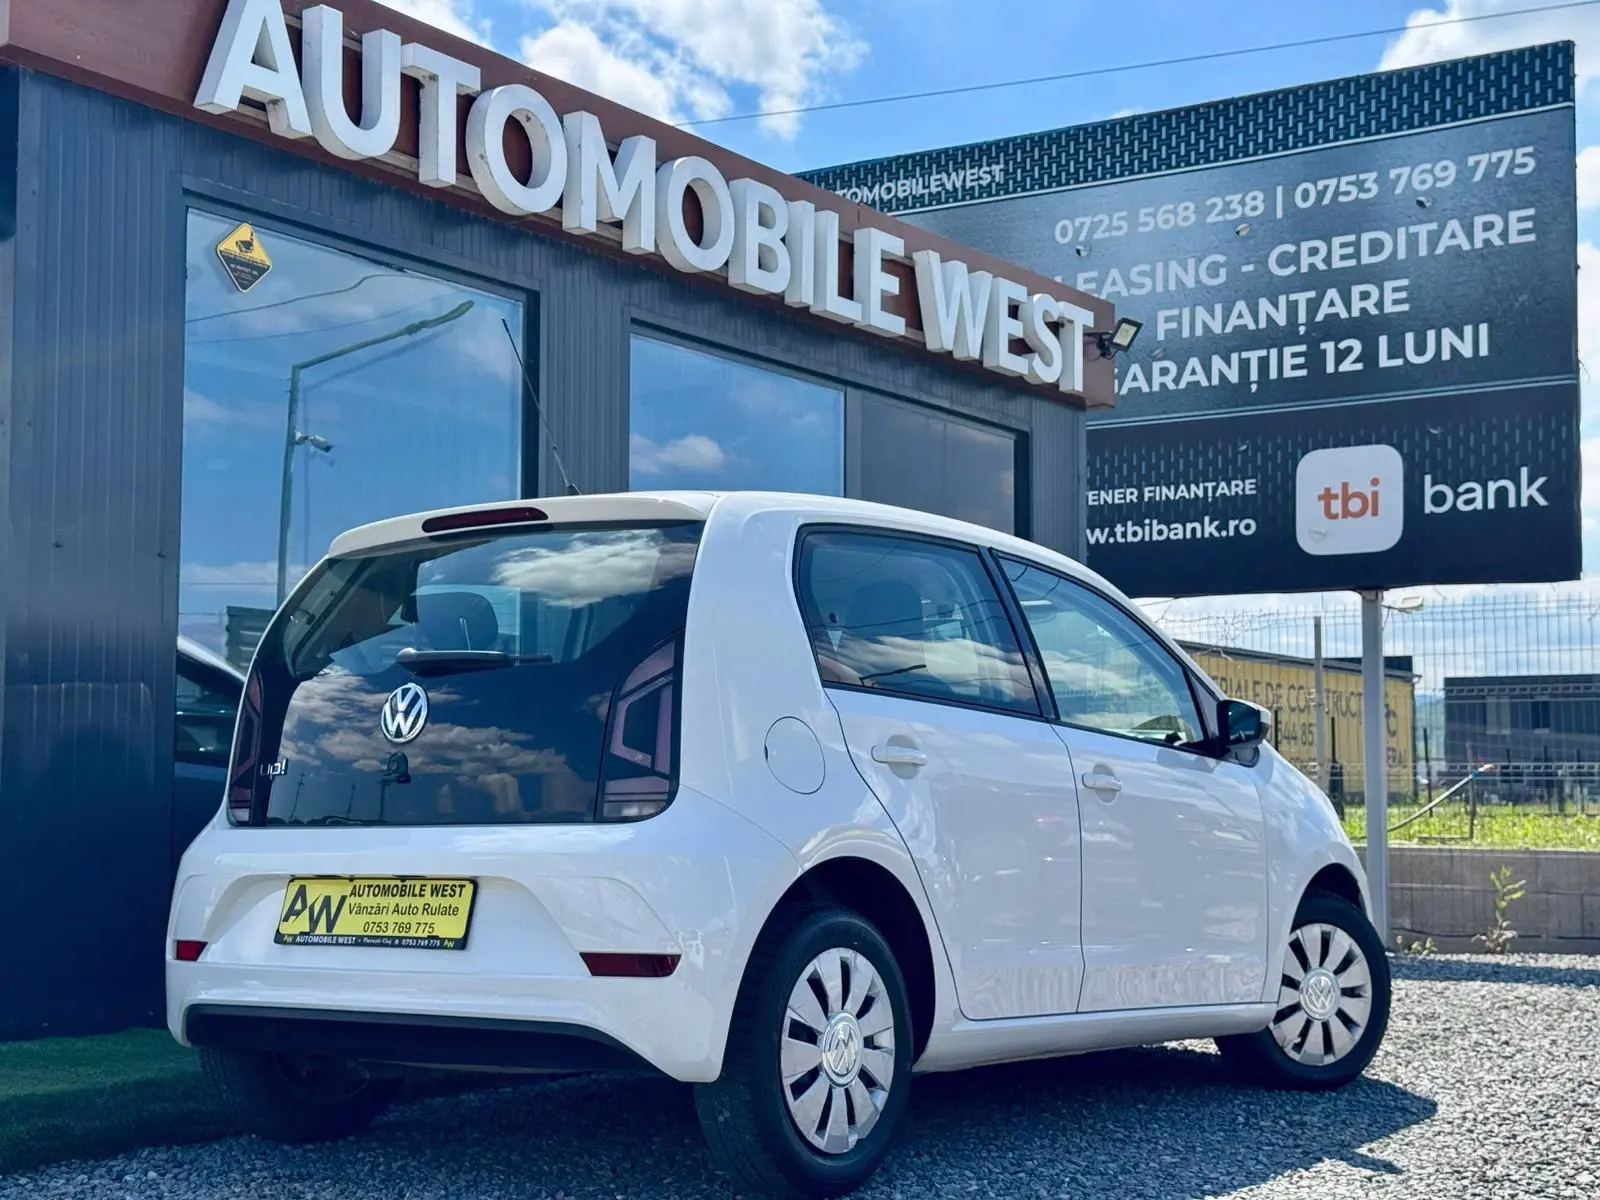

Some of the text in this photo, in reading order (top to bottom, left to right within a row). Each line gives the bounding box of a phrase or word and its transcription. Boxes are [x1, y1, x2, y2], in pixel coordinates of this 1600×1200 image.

[194, 0, 1094, 394] AUTOMOBILE WEST
[1054, 211, 1128, 244] 0725
[1137, 201, 1196, 233] 568
[1205, 190, 1265, 223] 238
[1294, 171, 1379, 209] 0753
[1389, 160, 1457, 195] 769
[1467, 146, 1536, 183] 775
[1054, 253, 1227, 300] EASING
[1268, 207, 1537, 277] CREDITARE
[1156, 278, 1410, 341] FINANȚARE
[1114, 322, 1489, 396] ARANȚIE 12 LUNI
[1144, 478, 1257, 503] FINANȚARE
[1317, 476, 1380, 520] tbi
[1423, 466, 1548, 514] bank
[349, 883, 466, 898] AUTOMOBILE WEST
[392, 902, 419, 916] Auto
[421, 902, 460, 916] Rulate
[295, 935, 337, 944] AUTOMOBILE
[338, 936, 356, 944] WEST
[363, 921, 436, 934] 0753 769 775
